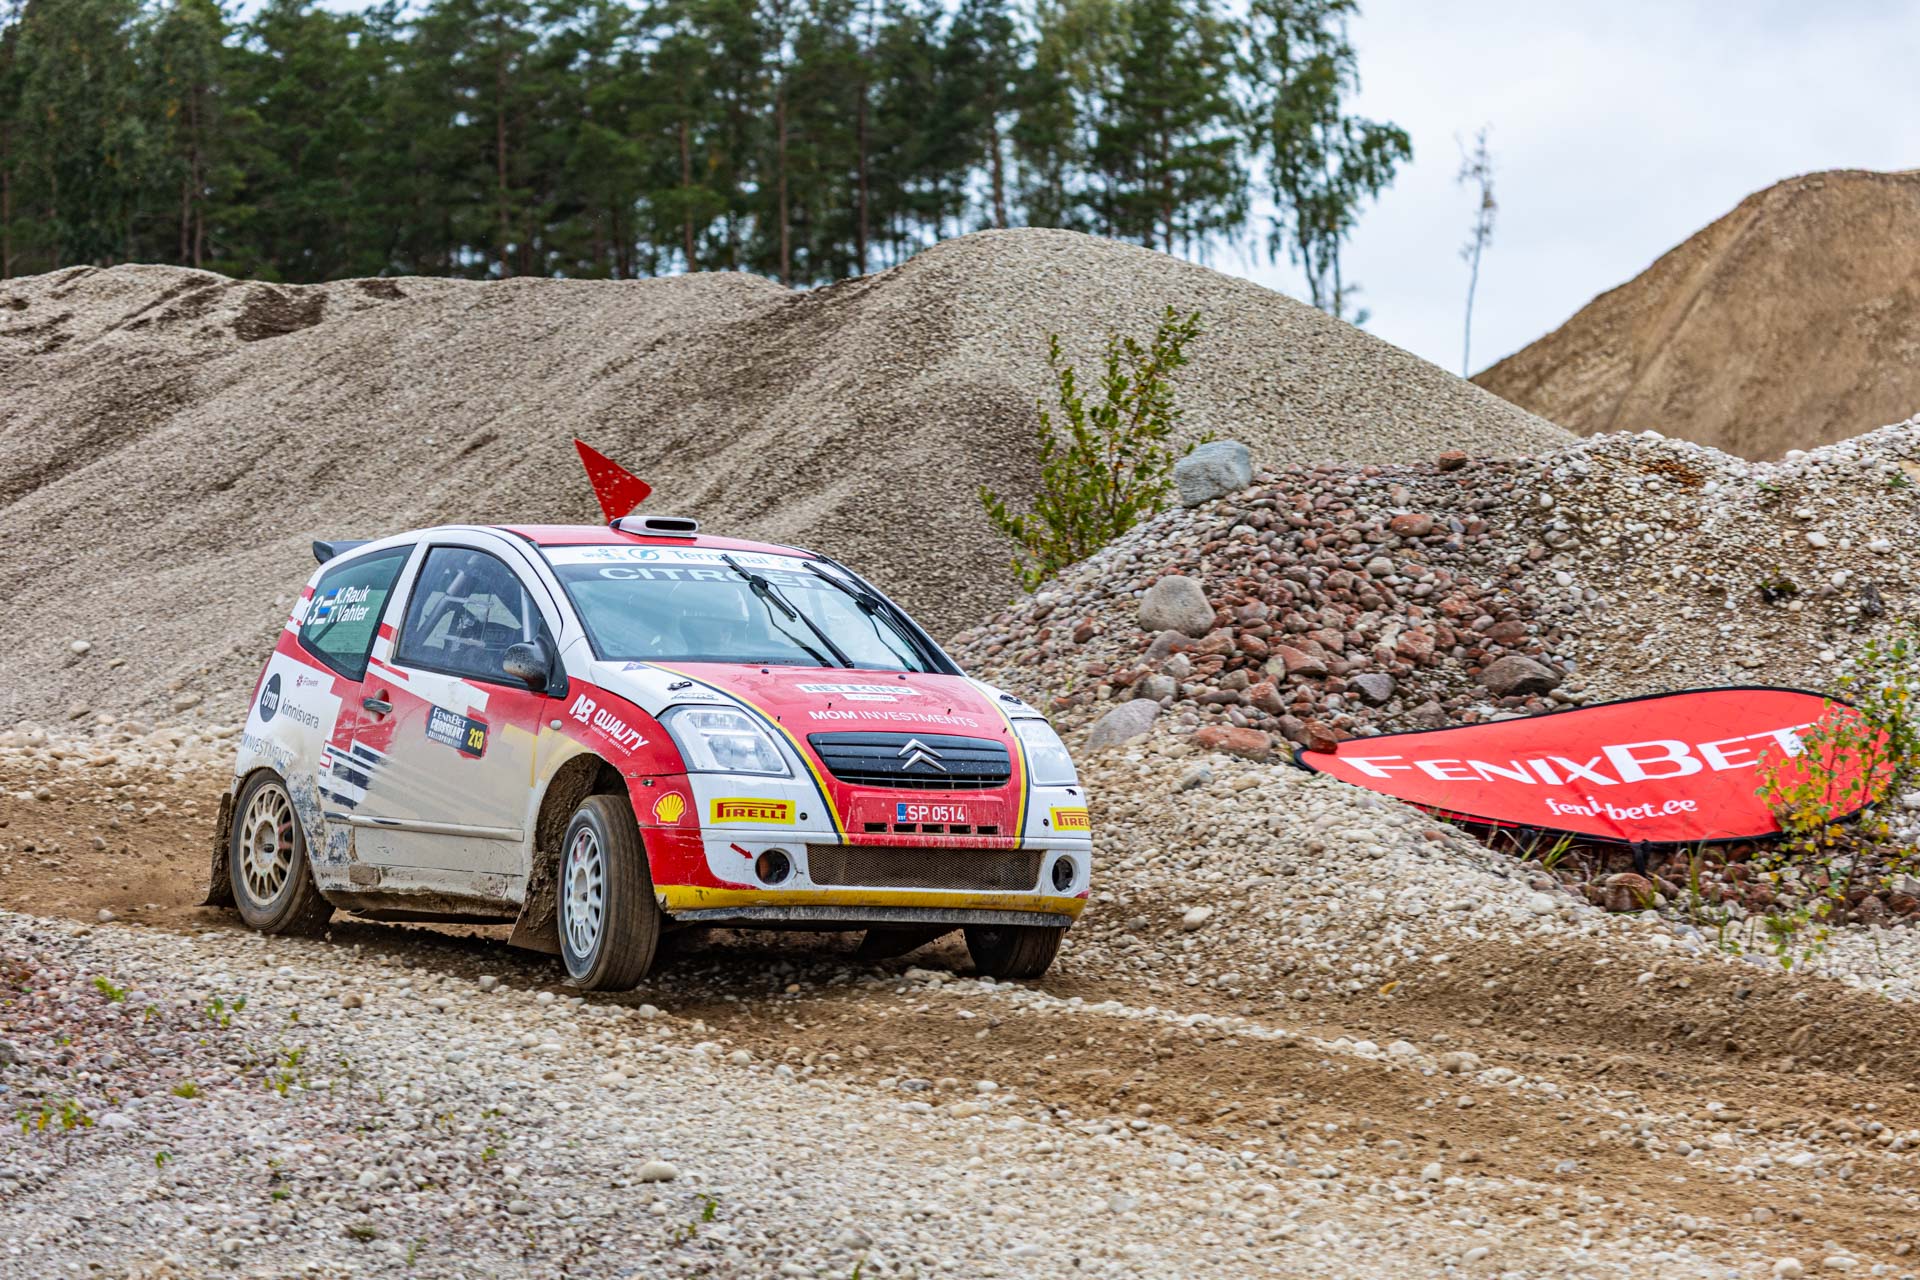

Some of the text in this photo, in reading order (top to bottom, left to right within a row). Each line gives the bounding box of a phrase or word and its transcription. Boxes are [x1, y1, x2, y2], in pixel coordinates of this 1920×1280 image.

[281, 697, 320, 729] kinnisvara
[808, 711, 979, 728] MOM INVESTMENTS
[467, 728, 485, 750] 213
[594, 708, 650, 752] QUALITY
[717, 802, 788, 820] PIRELLI
[907, 805, 965, 822] SP 0514
